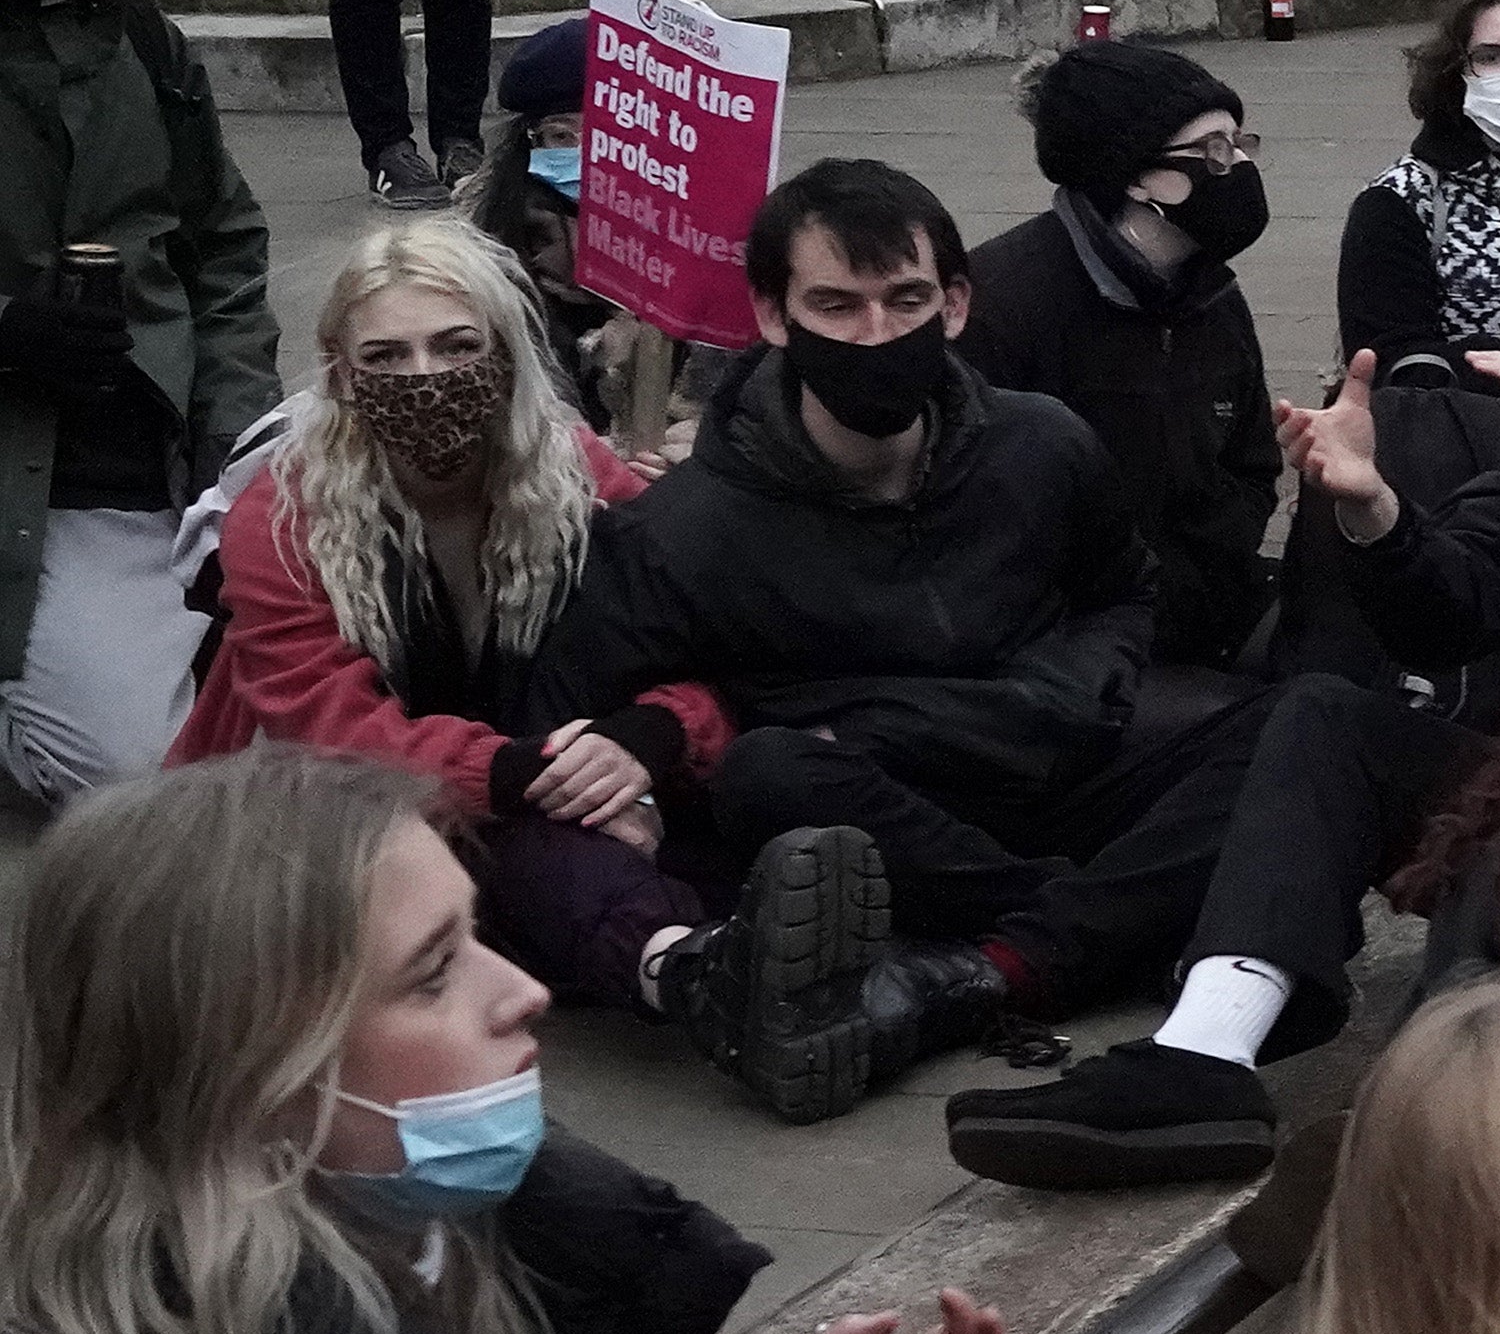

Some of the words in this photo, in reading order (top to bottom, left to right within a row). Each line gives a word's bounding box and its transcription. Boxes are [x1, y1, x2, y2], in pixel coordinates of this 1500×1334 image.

[660, 23, 676, 45] TO
[677, 30, 722, 63] RACISM
[661, 5, 697, 31] STAND
[697, 20, 716, 40] UP
[596, 22, 692, 102] Defend
[696, 75, 755, 124] the
[593, 78, 662, 138] right
[668, 110, 698, 154] to
[590, 127, 690, 201] protest
[588, 166, 662, 235] Black
[667, 205, 748, 267] Lives
[588, 214, 676, 288] Matter
